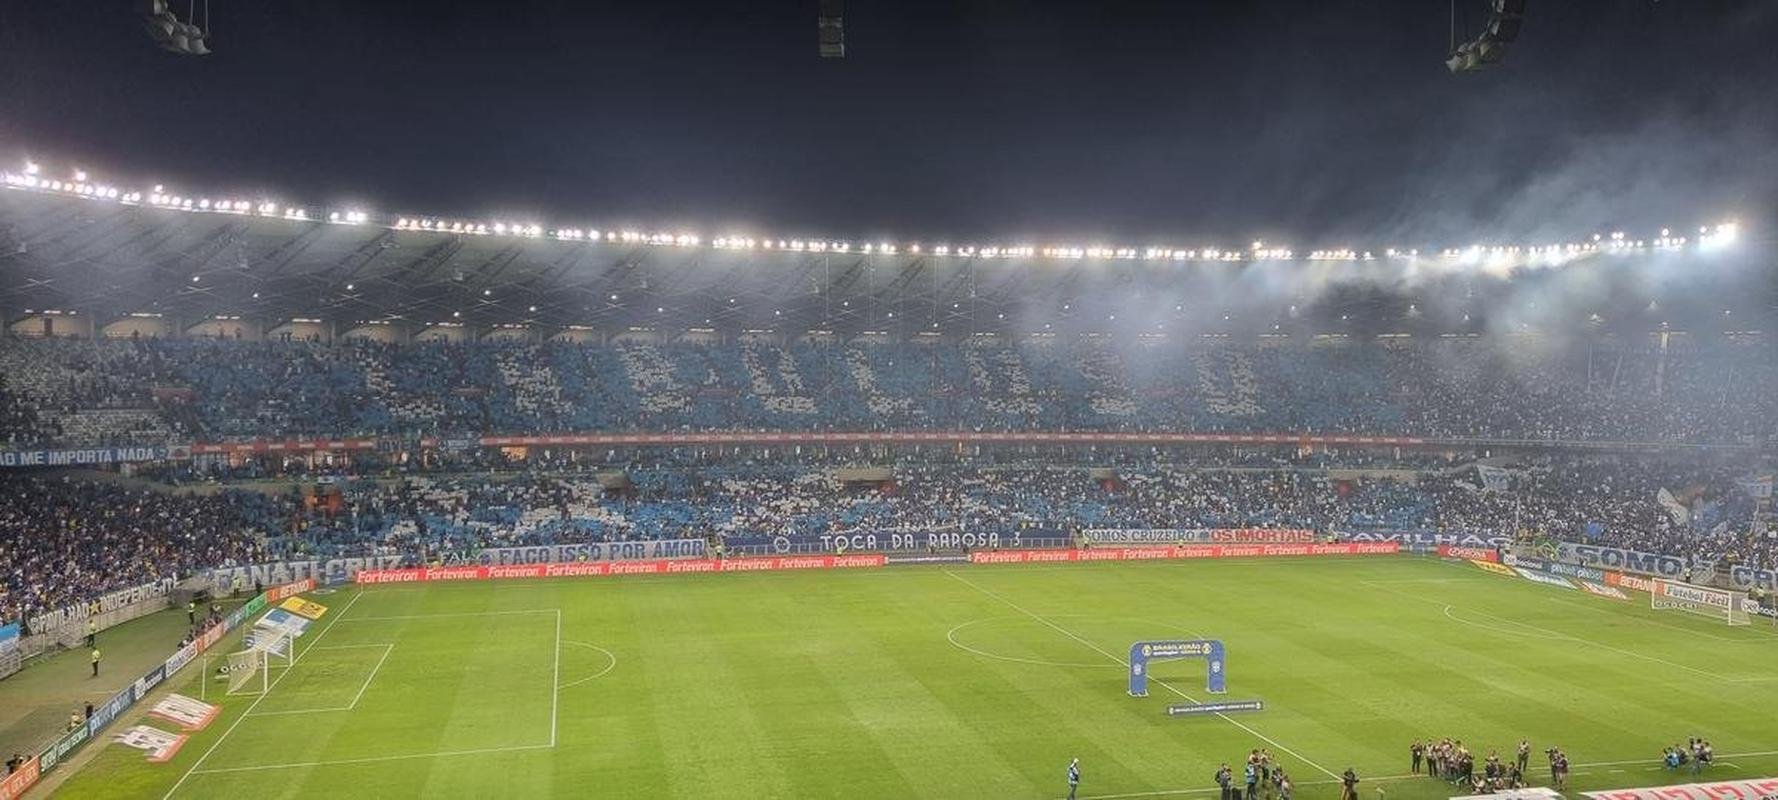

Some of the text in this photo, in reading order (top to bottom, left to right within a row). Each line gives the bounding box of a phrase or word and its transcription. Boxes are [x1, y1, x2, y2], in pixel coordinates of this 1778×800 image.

[20, 451, 45, 466] ME
[49, 450, 112, 465] IMPORTA
[117, 447, 154, 461] NADA
[820, 535, 877, 550] TOCA
[892, 534, 914, 548] DA
[1083, 529, 1196, 542] SOMOS CRUZEIRO
[1236, 529, 1313, 542] IMORTAIS
[559, 544, 602, 564] ISSO
[610, 543, 645, 561] POR
[653, 540, 705, 558] AMOR
[358, 569, 418, 584] Forteviron
[426, 567, 478, 580] Forteviron
[489, 564, 540, 578] Forteviron
[546, 561, 602, 576] Forteviron
[609, 560, 658, 574] Forteviron
[667, 558, 714, 572] Forteviron
[720, 556, 773, 572] Forteviron
[974, 551, 1022, 563] Forteviron
